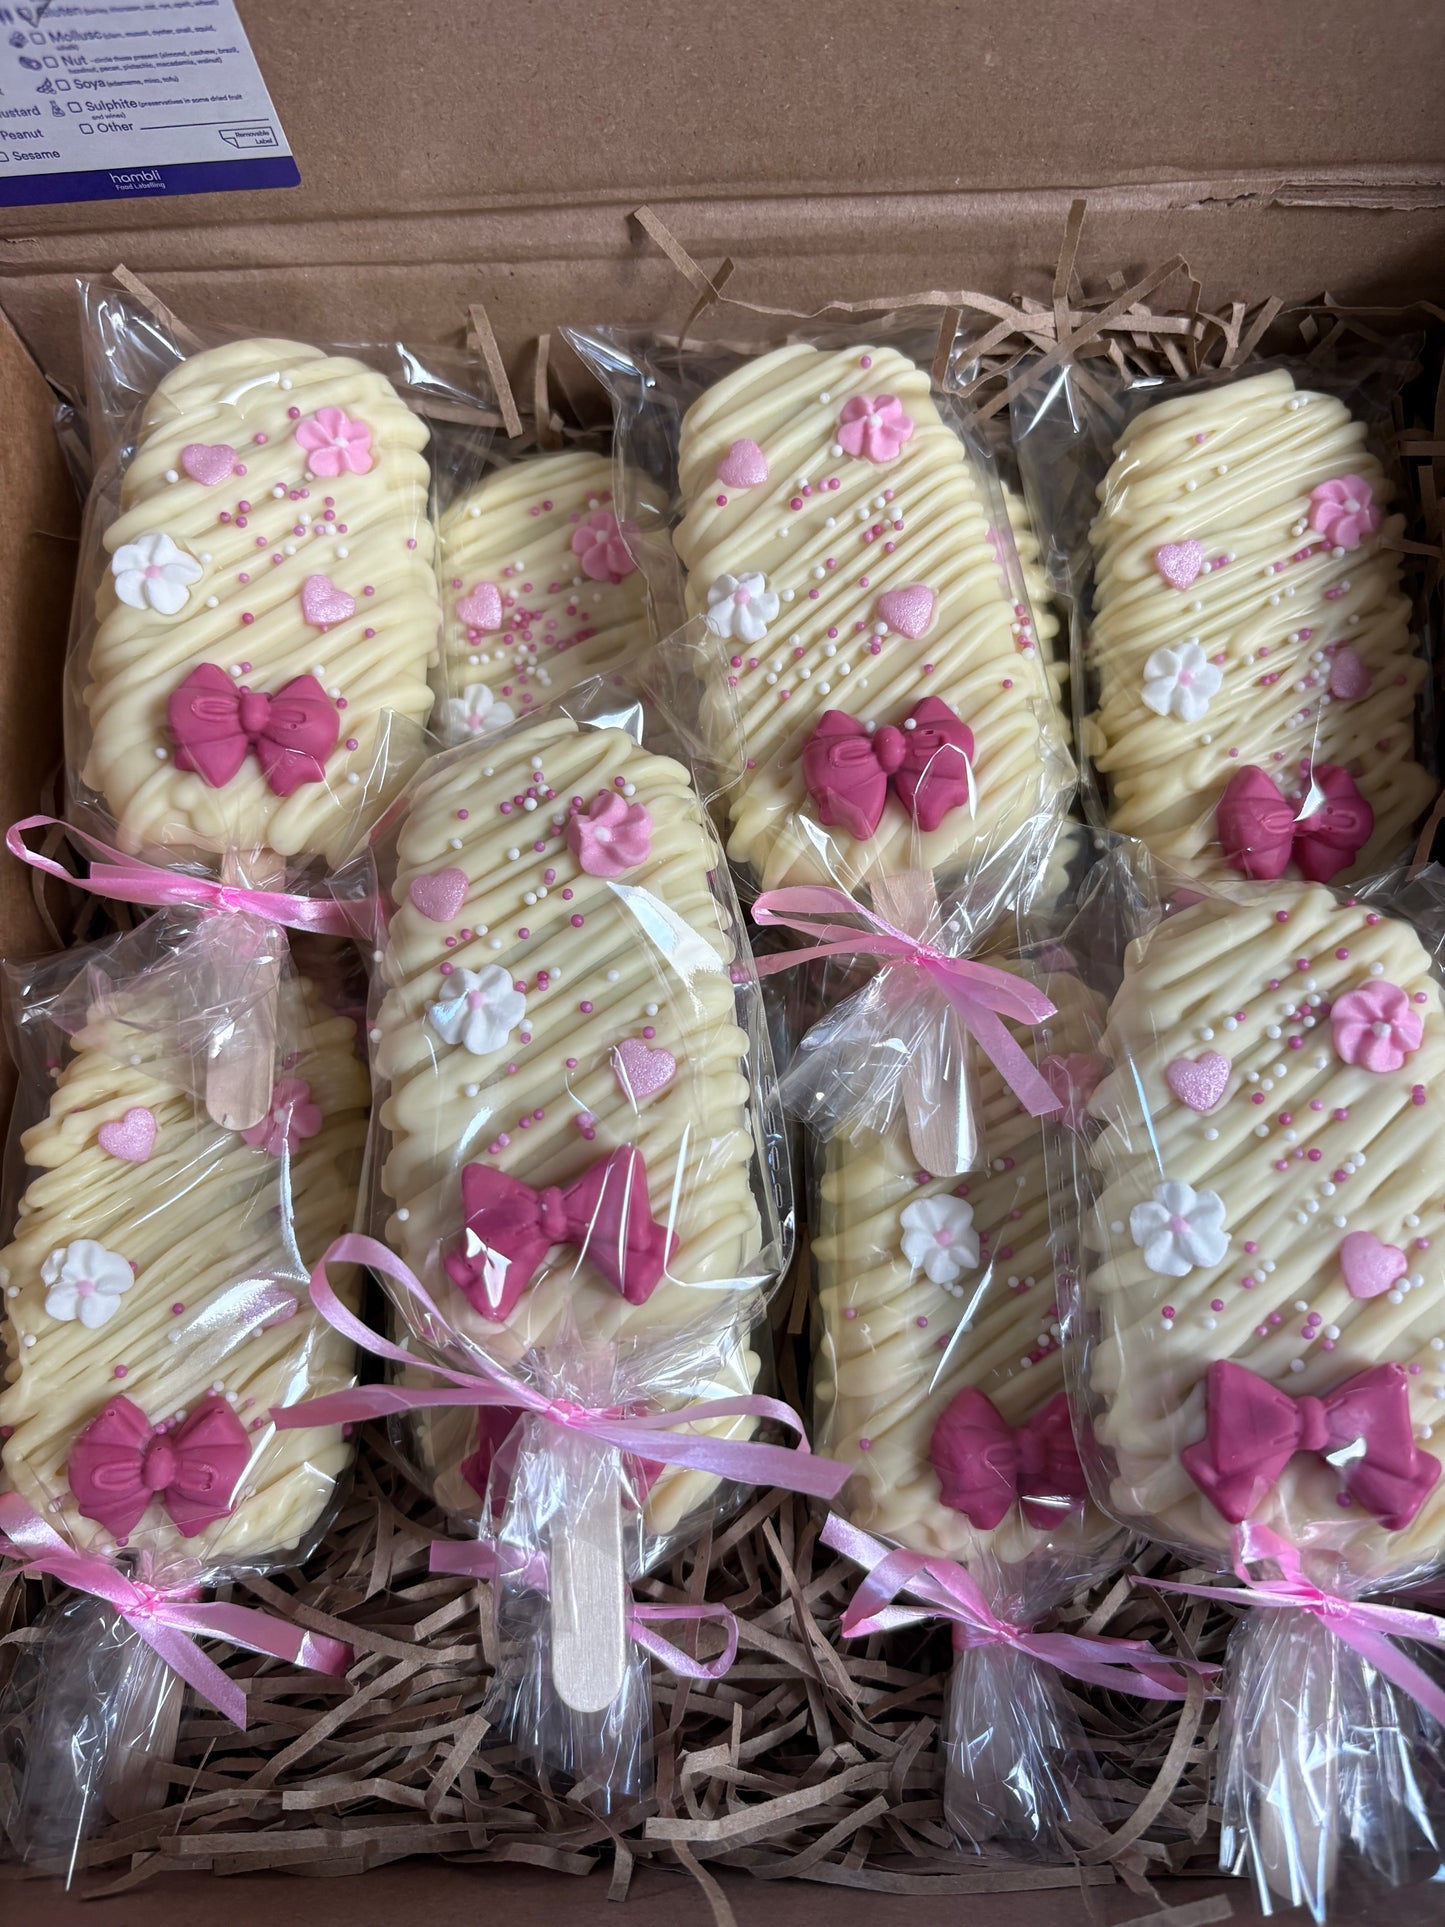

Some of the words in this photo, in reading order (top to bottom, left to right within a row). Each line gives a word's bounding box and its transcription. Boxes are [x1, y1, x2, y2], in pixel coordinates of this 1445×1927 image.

[61, 55, 88, 66] Nut
[73, 79, 106, 91] Soya
[85, 98, 138, 113] Sulphite
[210, 94, 227, 102] dried
[92, 113, 105, 121] and
[97, 121, 134, 133] Other
[0, 128, 44, 140] Peanut
[235, 130, 270, 138] Removable
[12, 150, 61, 161] Sesame
[109, 169, 162, 183] hambli
[115, 183, 135, 191] Food
[133, 181, 166, 190] Labelling
